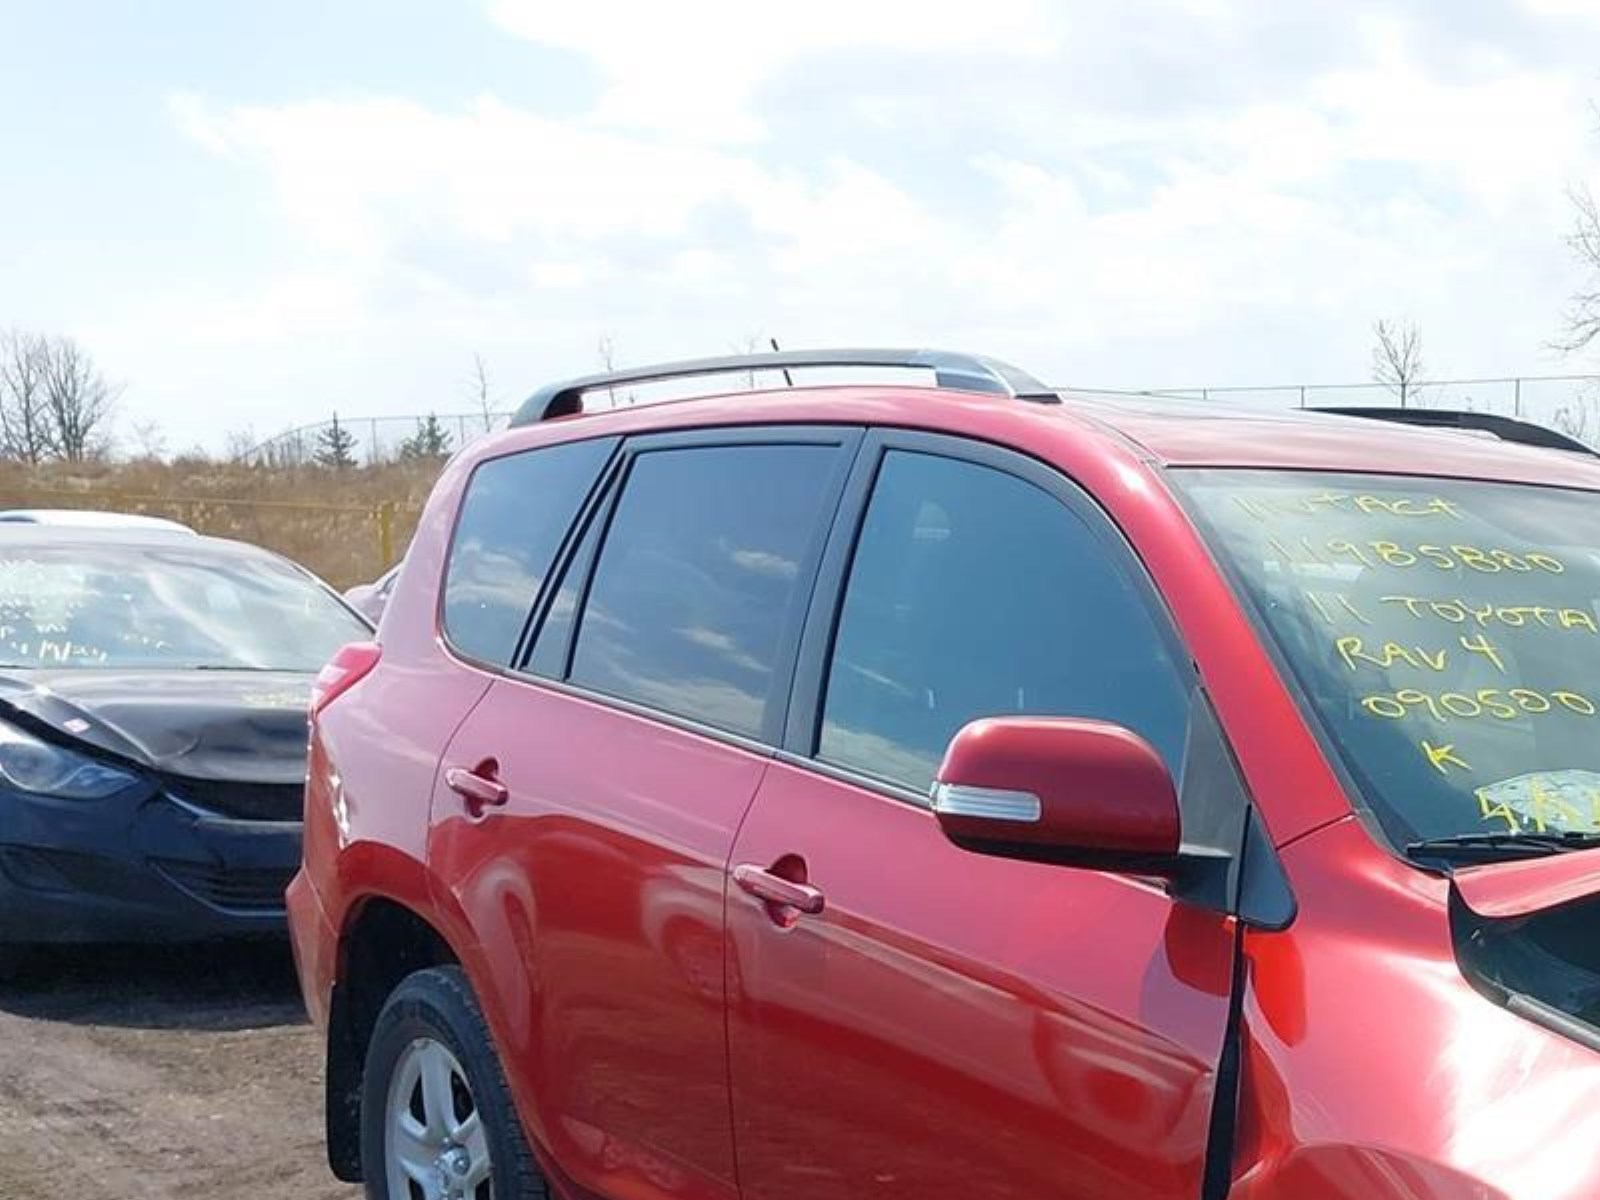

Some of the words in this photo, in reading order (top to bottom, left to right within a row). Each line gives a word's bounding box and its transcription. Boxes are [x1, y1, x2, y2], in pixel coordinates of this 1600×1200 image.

[1266, 535, 1566, 576] 11985800
[1379, 595, 1599, 635] TOYOTA
[1335, 636, 1447, 672] RAV
[1459, 634, 1505, 673] 4
